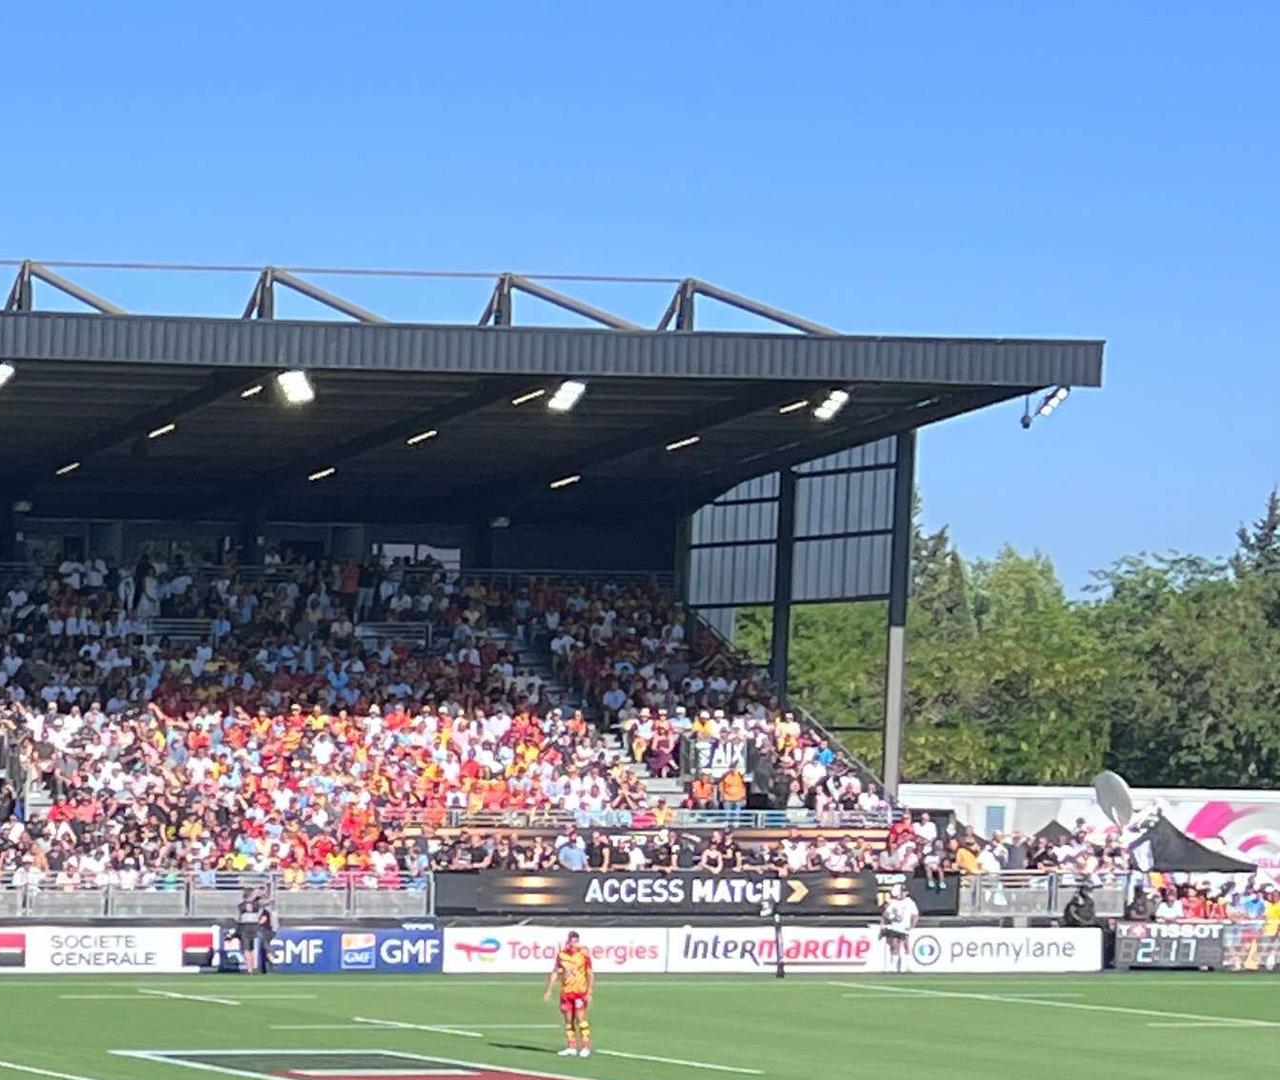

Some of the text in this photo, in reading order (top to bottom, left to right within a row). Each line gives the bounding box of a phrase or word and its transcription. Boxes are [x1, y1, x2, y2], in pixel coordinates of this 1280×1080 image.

[584, 879, 781, 902] ACCESS MATCH
[50, 934, 137, 949] SOCIETE
[1148, 924, 1223, 938] TISSOT
[50, 952, 157, 967] GENERALE
[268, 938, 324, 964] GMF
[379, 938, 440, 965] GMF
[506, 939, 659, 964] Totalergies
[949, 937, 1076, 964] pennylane
